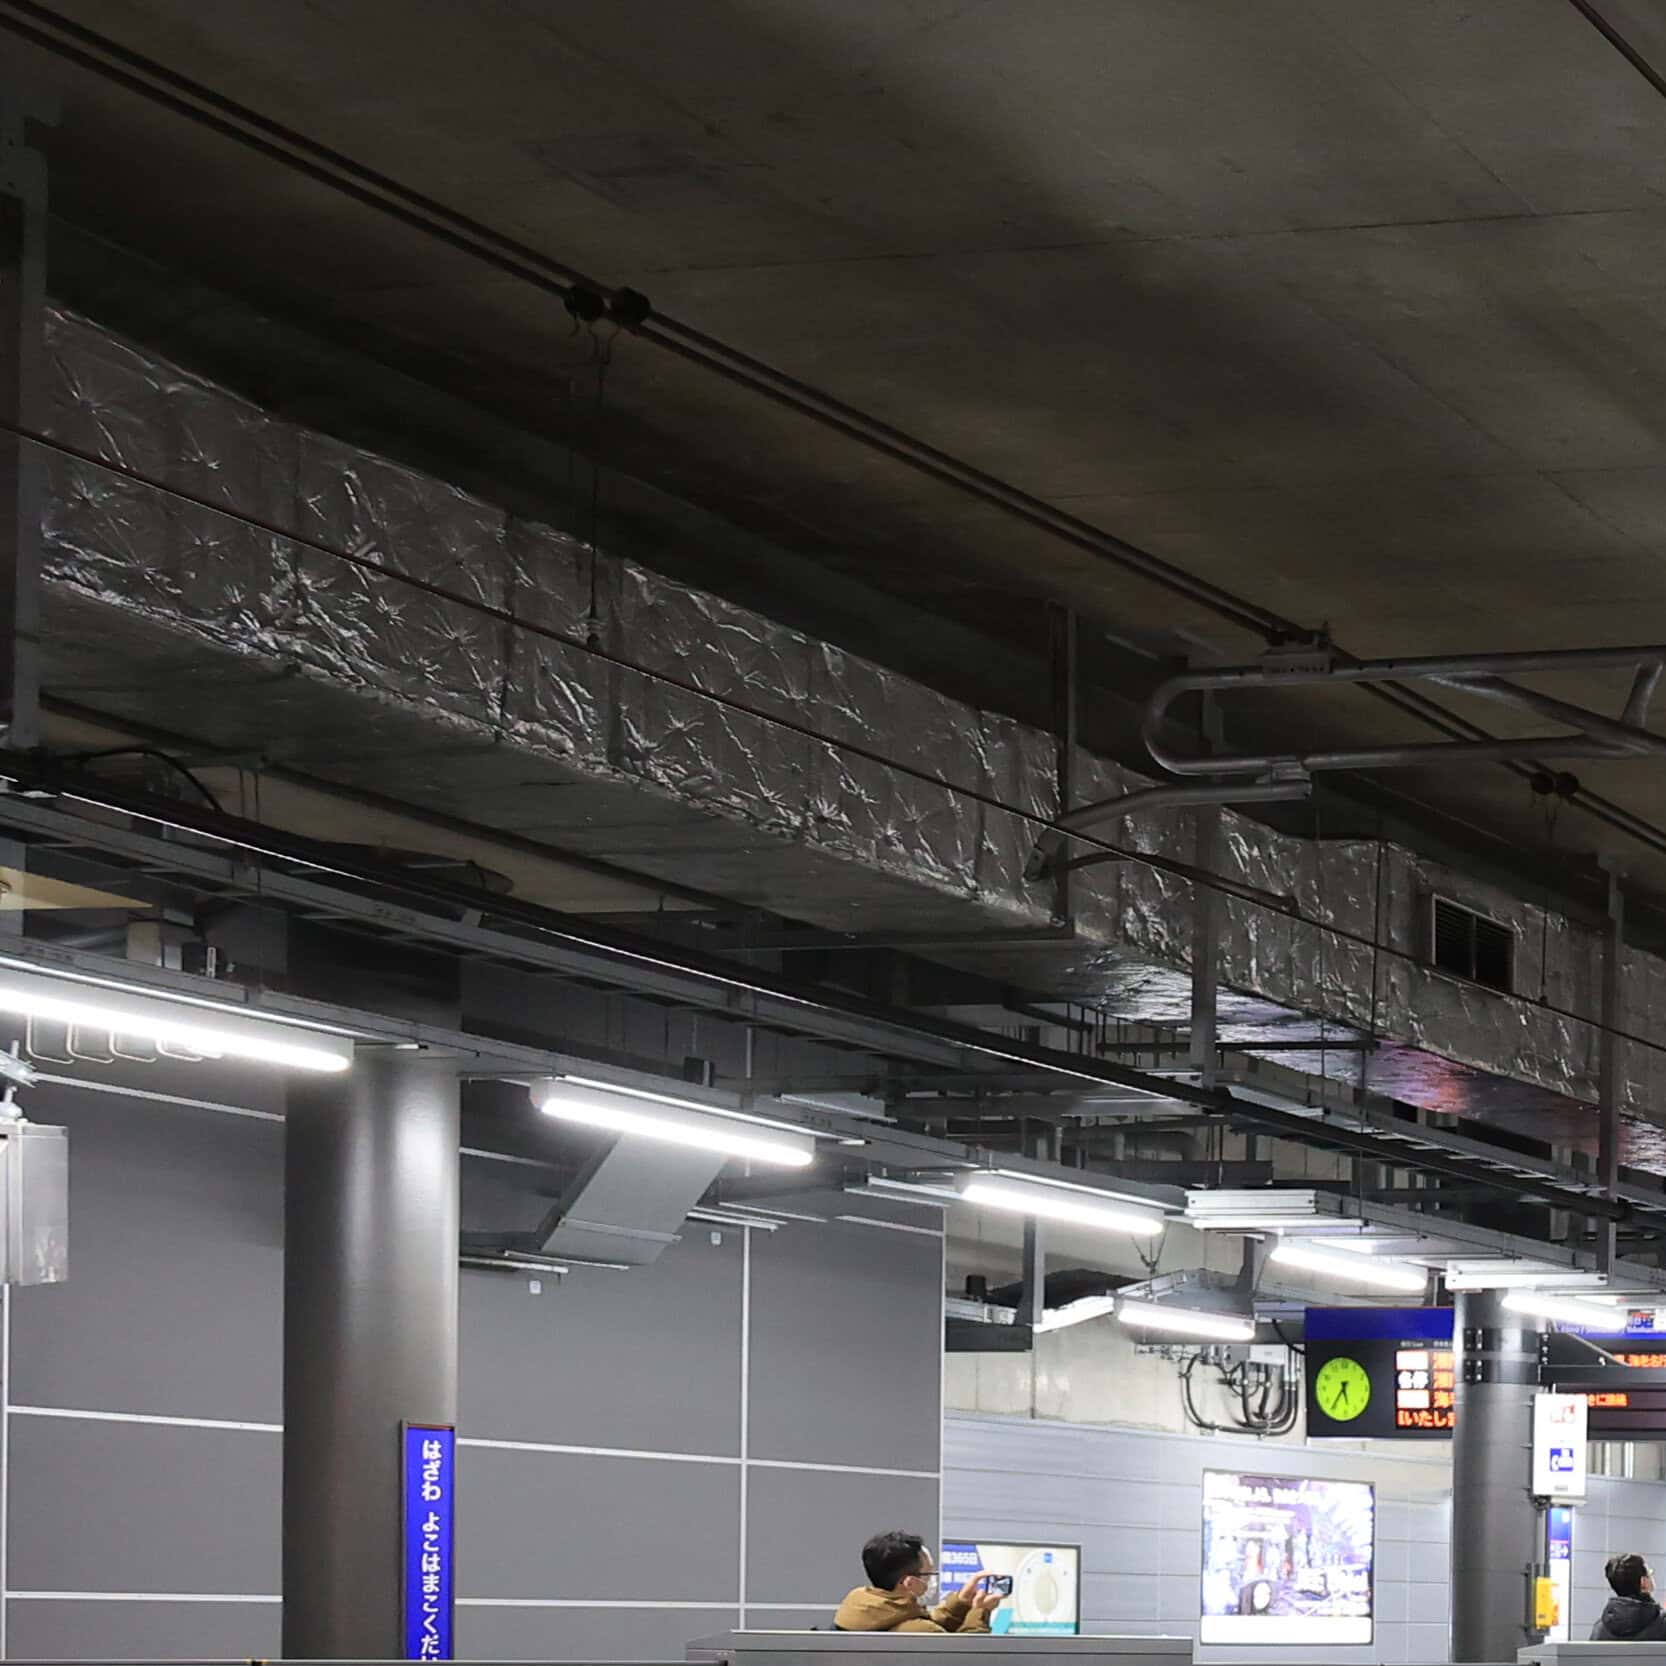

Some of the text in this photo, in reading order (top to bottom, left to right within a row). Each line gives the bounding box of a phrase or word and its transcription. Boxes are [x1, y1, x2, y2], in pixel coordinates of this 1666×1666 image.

[420, 1439, 442, 1661] はざわ よこはまこくだ
